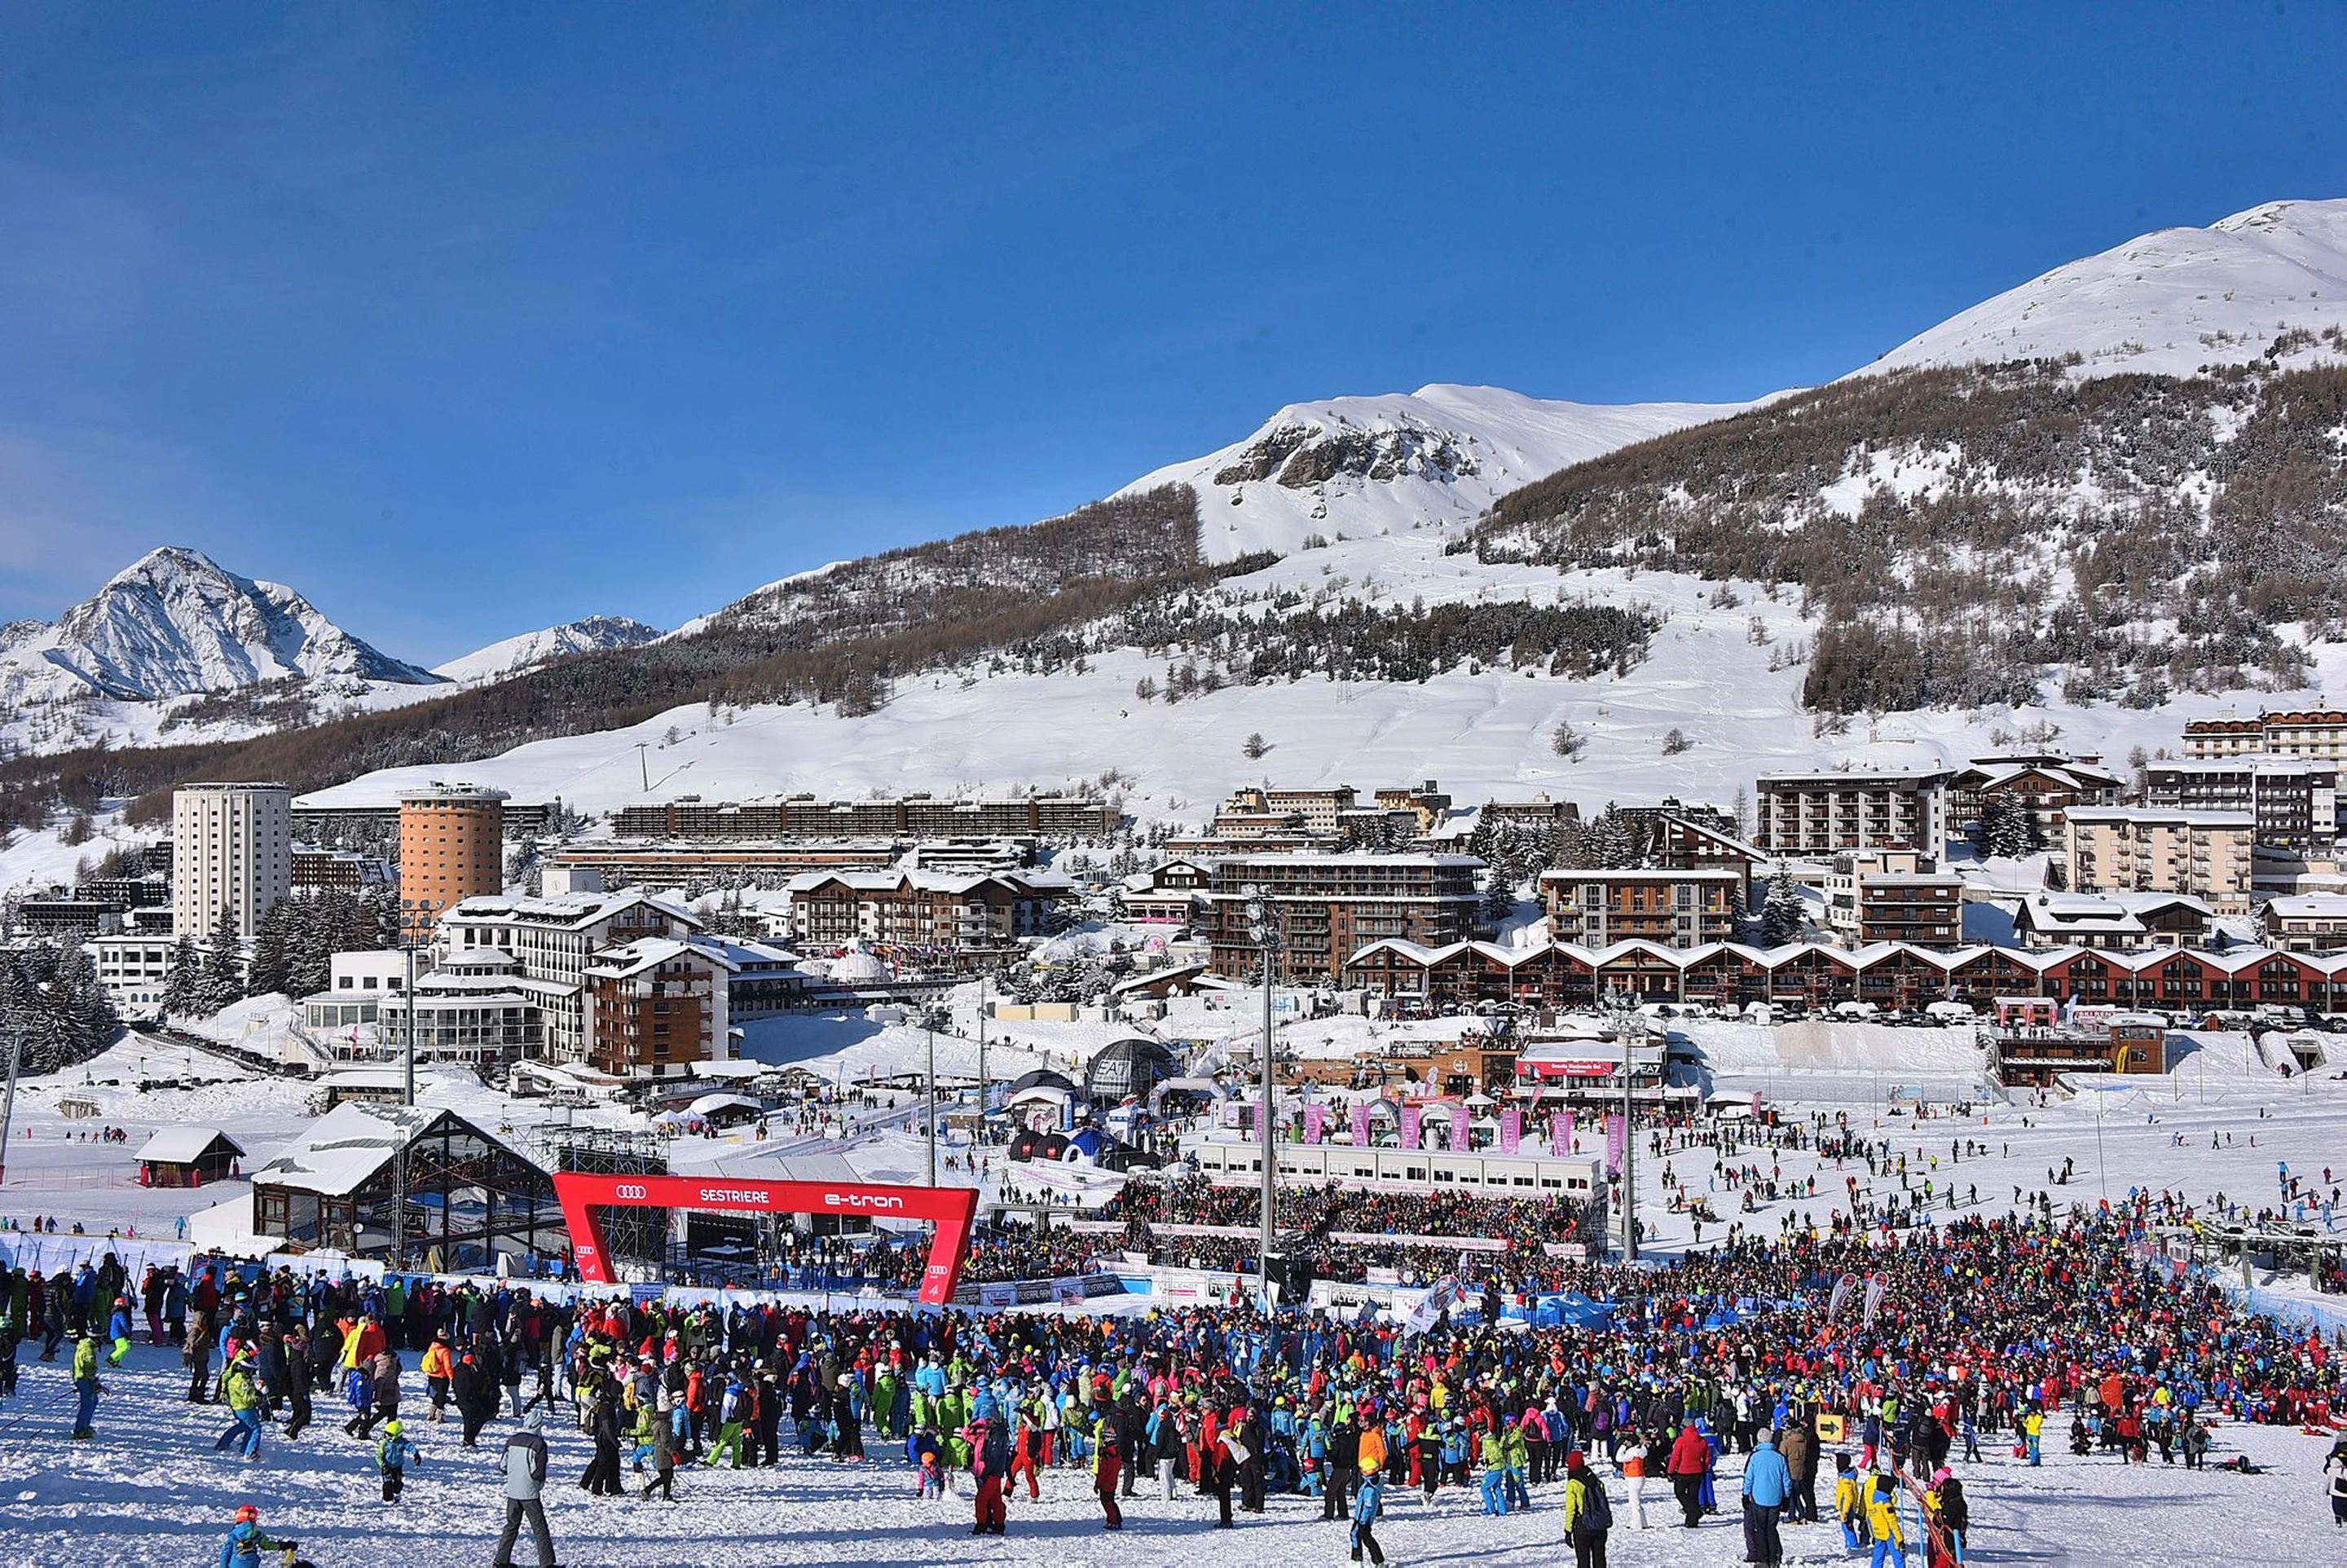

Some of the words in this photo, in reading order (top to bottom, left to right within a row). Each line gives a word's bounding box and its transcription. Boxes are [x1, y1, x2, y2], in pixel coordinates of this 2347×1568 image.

[1640, 1065, 1660, 1073] EA7
[701, 1189, 769, 1204] SESTRIERE
[824, 1193, 903, 1209] e-tron
